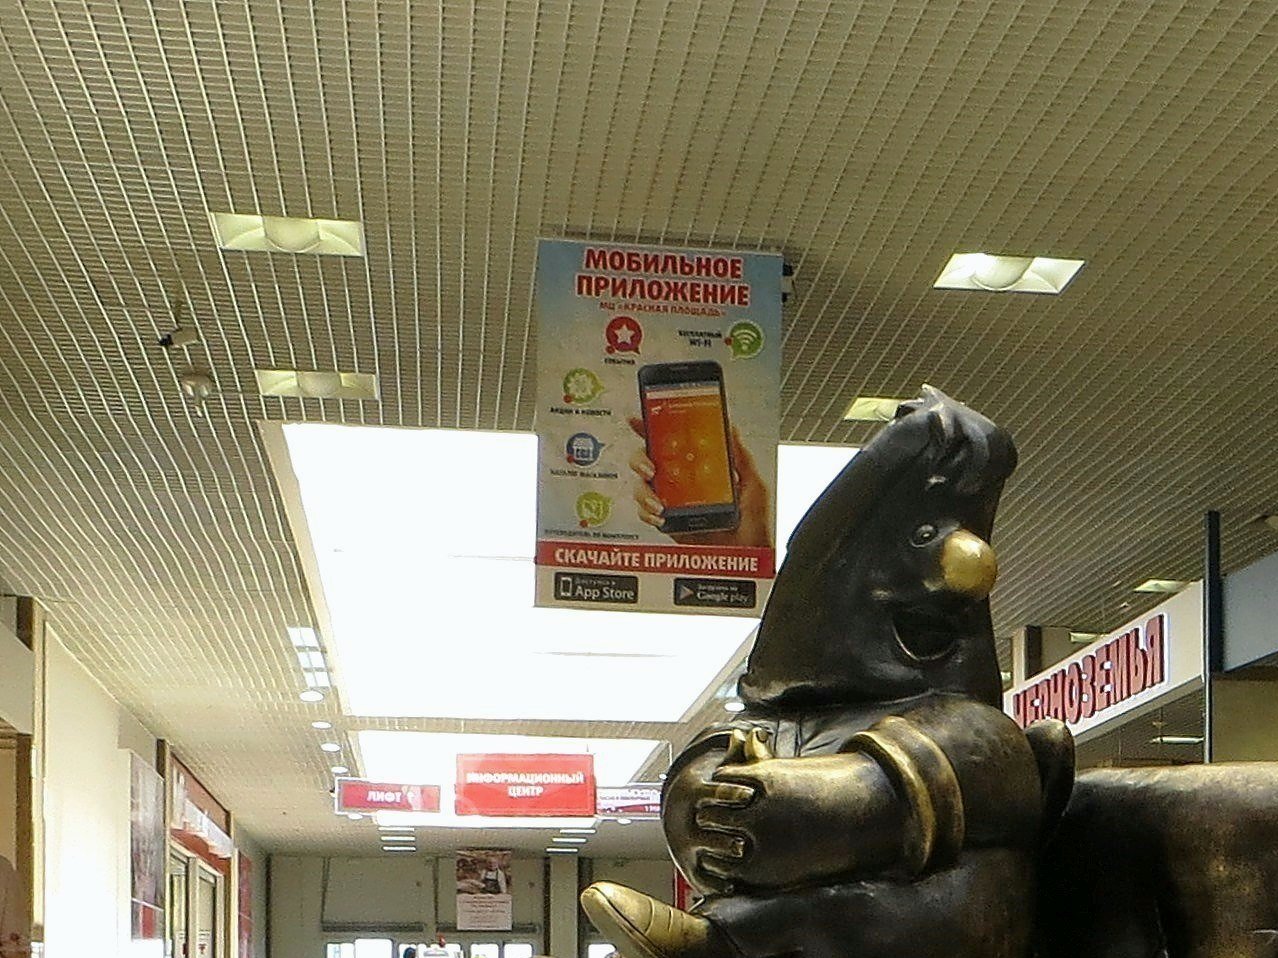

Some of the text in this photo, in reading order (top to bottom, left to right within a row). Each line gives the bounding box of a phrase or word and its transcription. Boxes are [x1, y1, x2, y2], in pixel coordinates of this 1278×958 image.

[585, 248, 742, 279] МОБИЛЬНОЕ
[576, 274, 750, 306] ПРИЛОЖЕНИЕ
[555, 547, 758, 571] СКАЧАЙТЕ ПРИЛОЖЕНИЕ
[574, 586, 635, 601] App Store
[1013, 614, 1164, 730] ЧЕРНОЗЕМЬЯ
[466, 771, 585, 784] ИНФОРМАЦИОННЫЙ
[366, 789, 401, 803] ЛИФТ
[506, 785, 545, 798] ЦЕНТР
